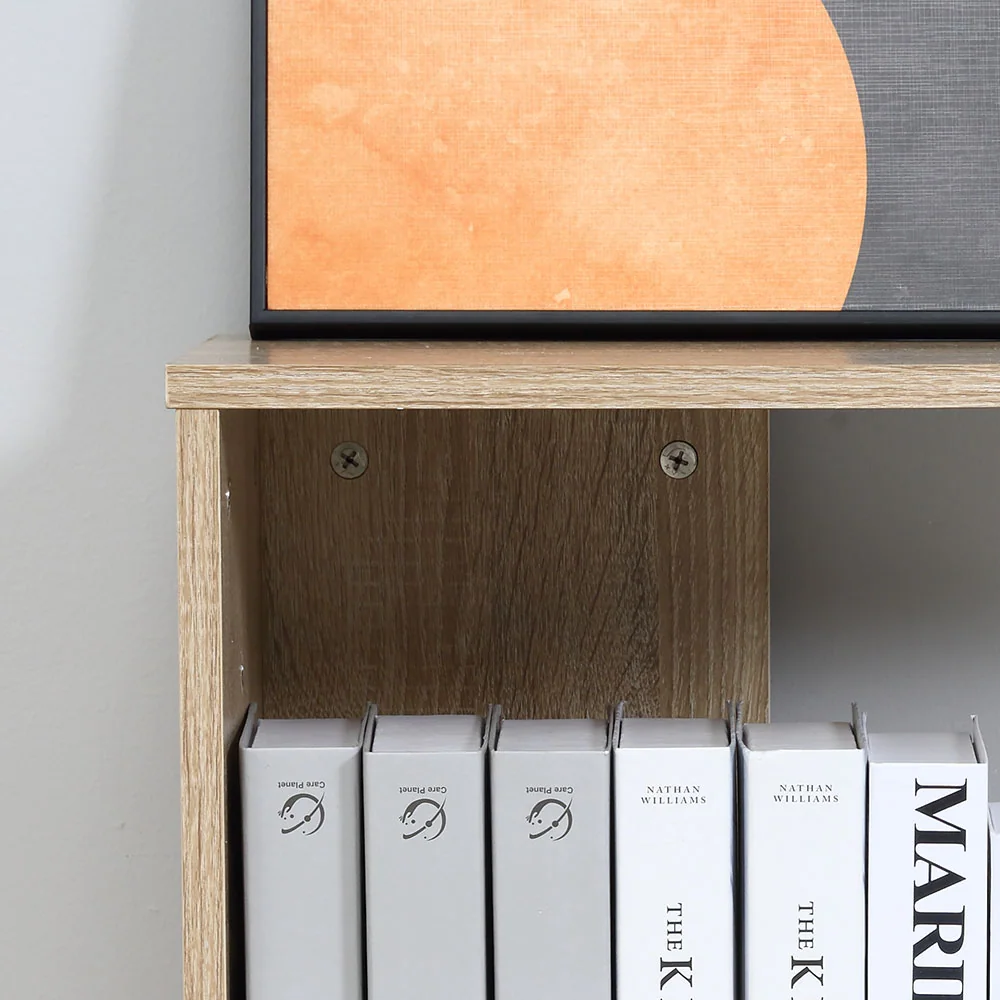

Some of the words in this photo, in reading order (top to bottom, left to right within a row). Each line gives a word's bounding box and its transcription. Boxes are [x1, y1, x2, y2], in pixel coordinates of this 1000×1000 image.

[277, 781, 304, 789] Planet
[305, 780, 326, 789] Care
[779, 784, 833, 792] NATHAN
[399, 786, 425, 795] Planet
[427, 786, 448, 794] Care
[525, 786, 551, 795] Planet
[553, 786, 574, 795] Care
[647, 785, 700, 794] NATHAN
[640, 796, 706, 805] WILLIAMS
[773, 794, 839, 803] WILLIAMS
[667, 903, 682, 951] THE
[799, 901, 813, 949] THE
